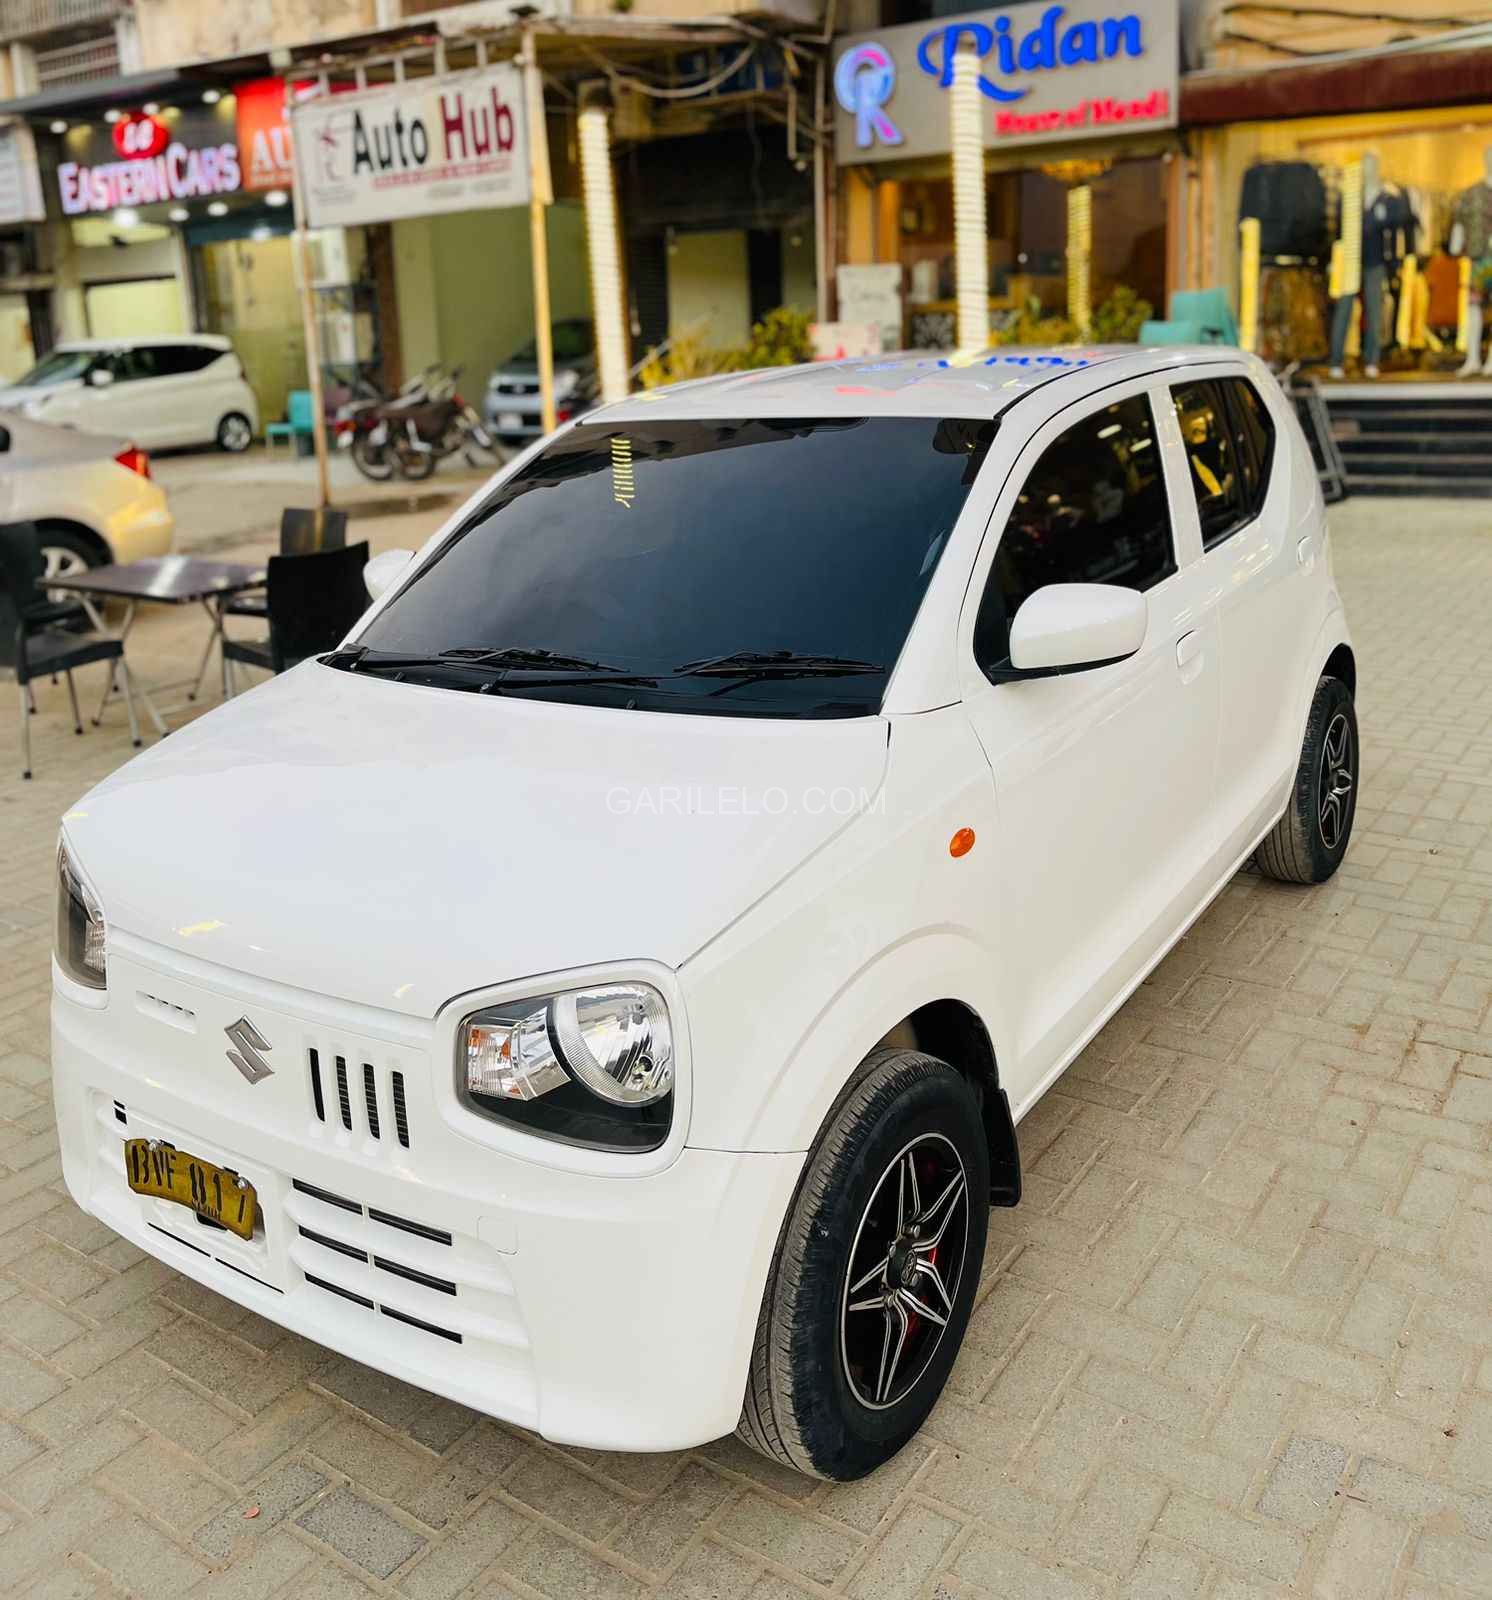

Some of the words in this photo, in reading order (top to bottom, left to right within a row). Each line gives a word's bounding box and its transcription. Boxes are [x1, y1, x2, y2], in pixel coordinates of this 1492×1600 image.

[917, 6, 1143, 103] Ridan
[353, 108, 429, 174] Auto
[440, 86, 514, 160] Hub
[131, 1144, 176, 1190] BVF
